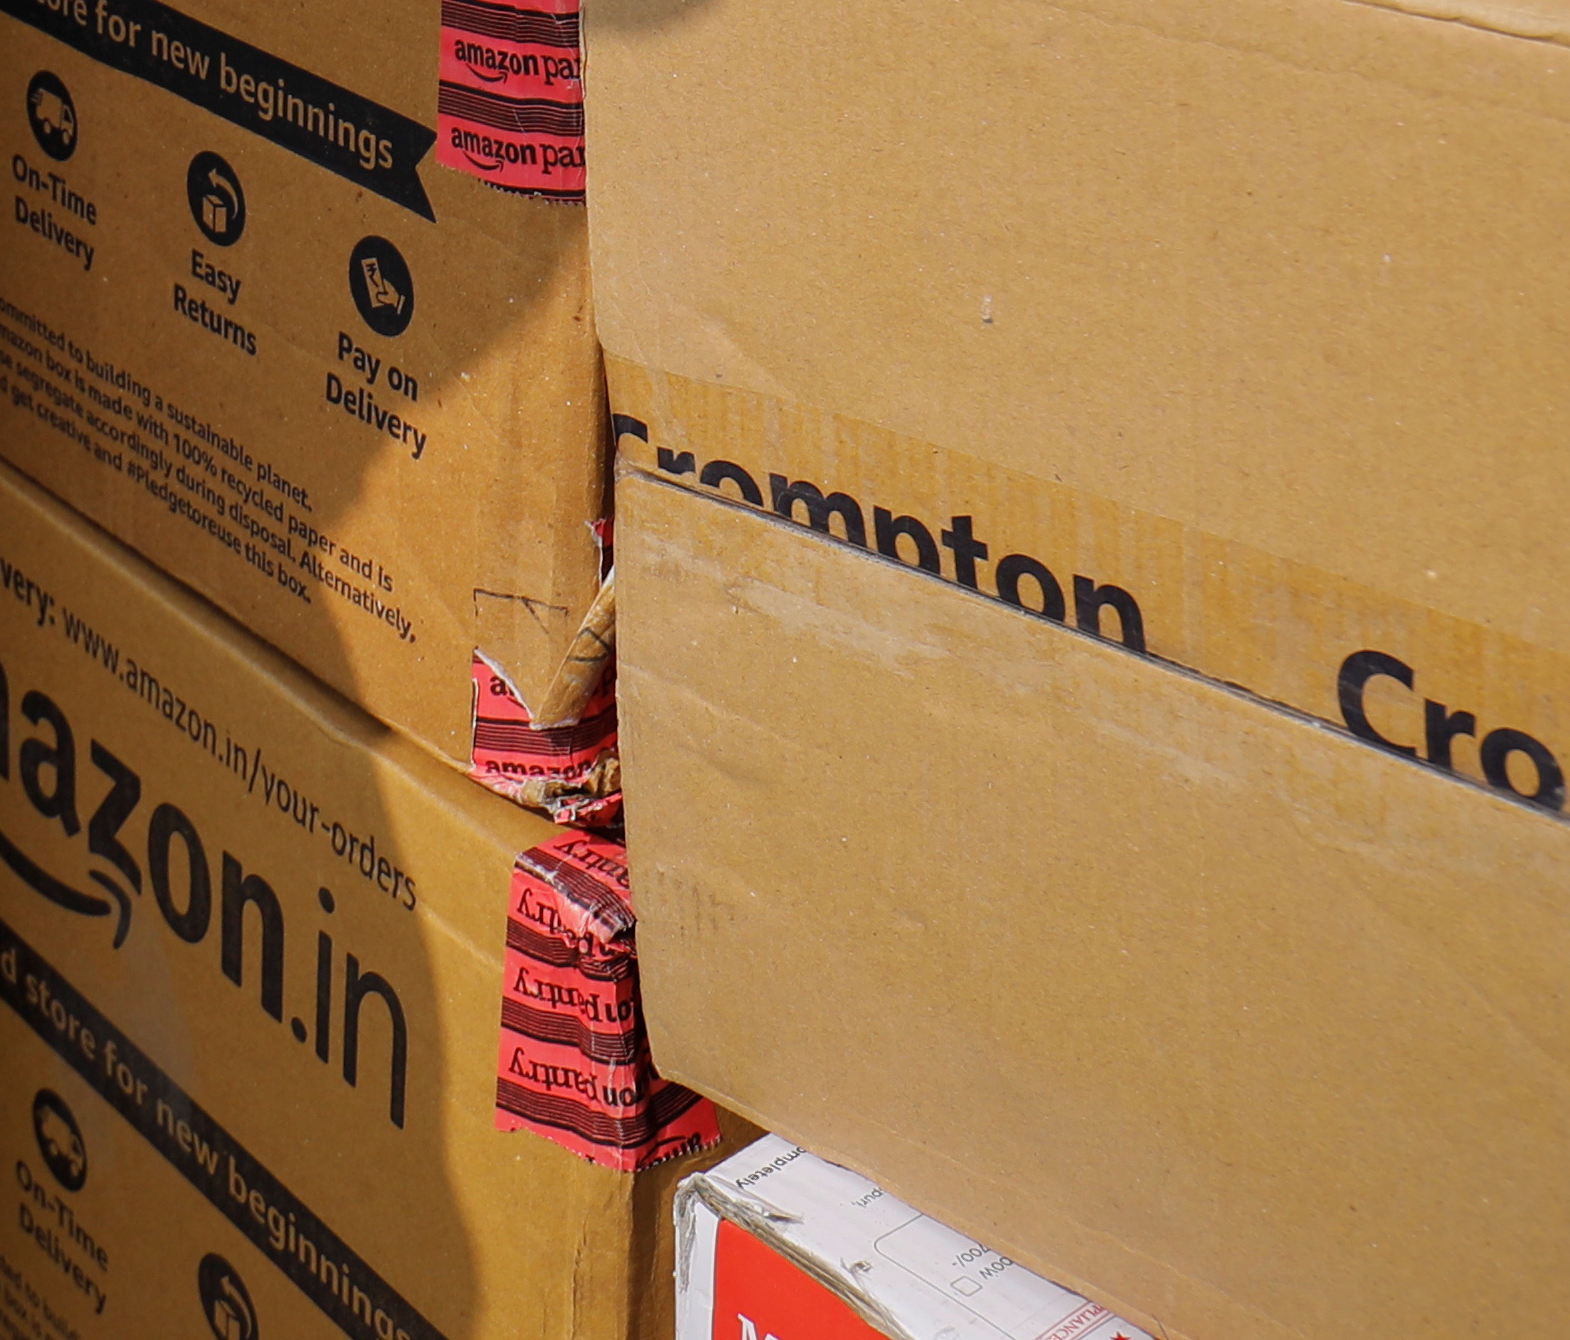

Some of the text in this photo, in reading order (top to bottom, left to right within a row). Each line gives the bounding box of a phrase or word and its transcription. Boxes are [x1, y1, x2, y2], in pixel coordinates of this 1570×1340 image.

[95, 0, 142, 48] for
[150, 26, 210, 81] new
[219, 53, 394, 170] beginnings
[454, 38, 539, 77] amazon
[13, 154, 96, 225] On-Time
[452, 126, 537, 166] amazon
[15, 196, 95, 269] Delivery
[191, 249, 241, 304] Easy
[174, 283, 256, 356] Returns
[338, 331, 419, 402] Pay on
[47, 349, 71, 384] box
[88, 383, 133, 421] made
[137, 411, 169, 445] with
[174, 434, 217, 476] 100%
[221, 468, 283, 523] recycled
[289, 513, 336, 556] paper
[340, 547, 372, 579] and
[379, 565, 393, 592] is
[68, 341, 83, 364] to
[86, 350, 151, 407] building
[154, 394, 163, 410] a
[168, 403, 253, 471] sustainable
[258, 463, 313, 511] planet.
[326, 372, 426, 459] Delivery
[37, 403, 311, 604] creative and #Pledgetoreuse this box.
[86, 408, 172, 478] accordingly
[176, 467, 226, 515] during
[229, 501, 296, 562] disposal.
[300, 550, 416, 644] Alternatively,
[62, 607, 418, 912] www.amazon.in/your-orders
[25, 962, 96, 1057] store
[103, 1037, 150, 1105] for
[158, 1097, 219, 1175] new
[16, 1160, 108, 1271] On-Time
[20, 1203, 106, 1315] Delivery
